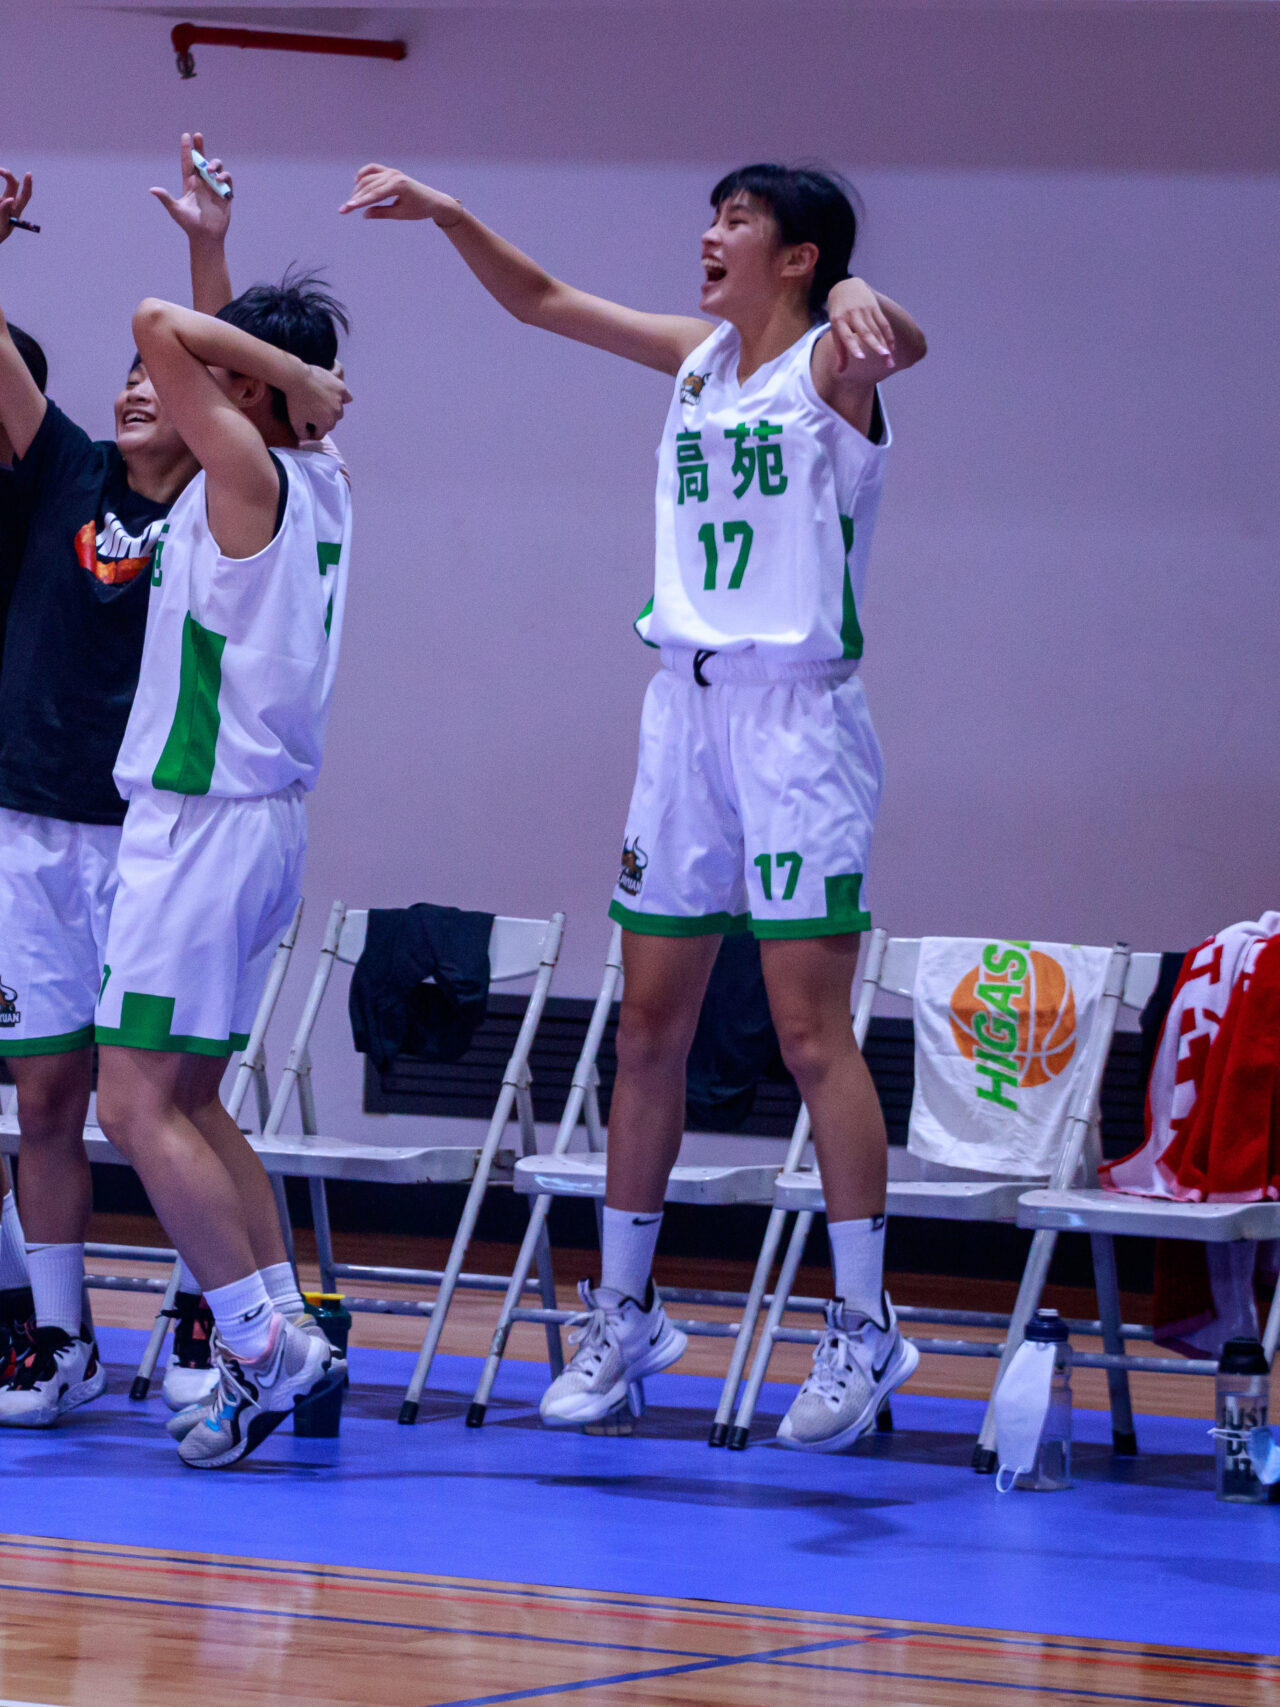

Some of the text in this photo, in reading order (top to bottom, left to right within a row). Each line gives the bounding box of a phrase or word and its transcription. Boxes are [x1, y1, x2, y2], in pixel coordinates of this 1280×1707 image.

[675, 420, 789, 506] 高苑
[698, 520, 754, 591] 17
[754, 851, 803, 901] 17
[972, 939, 1030, 1112] HIGAS
